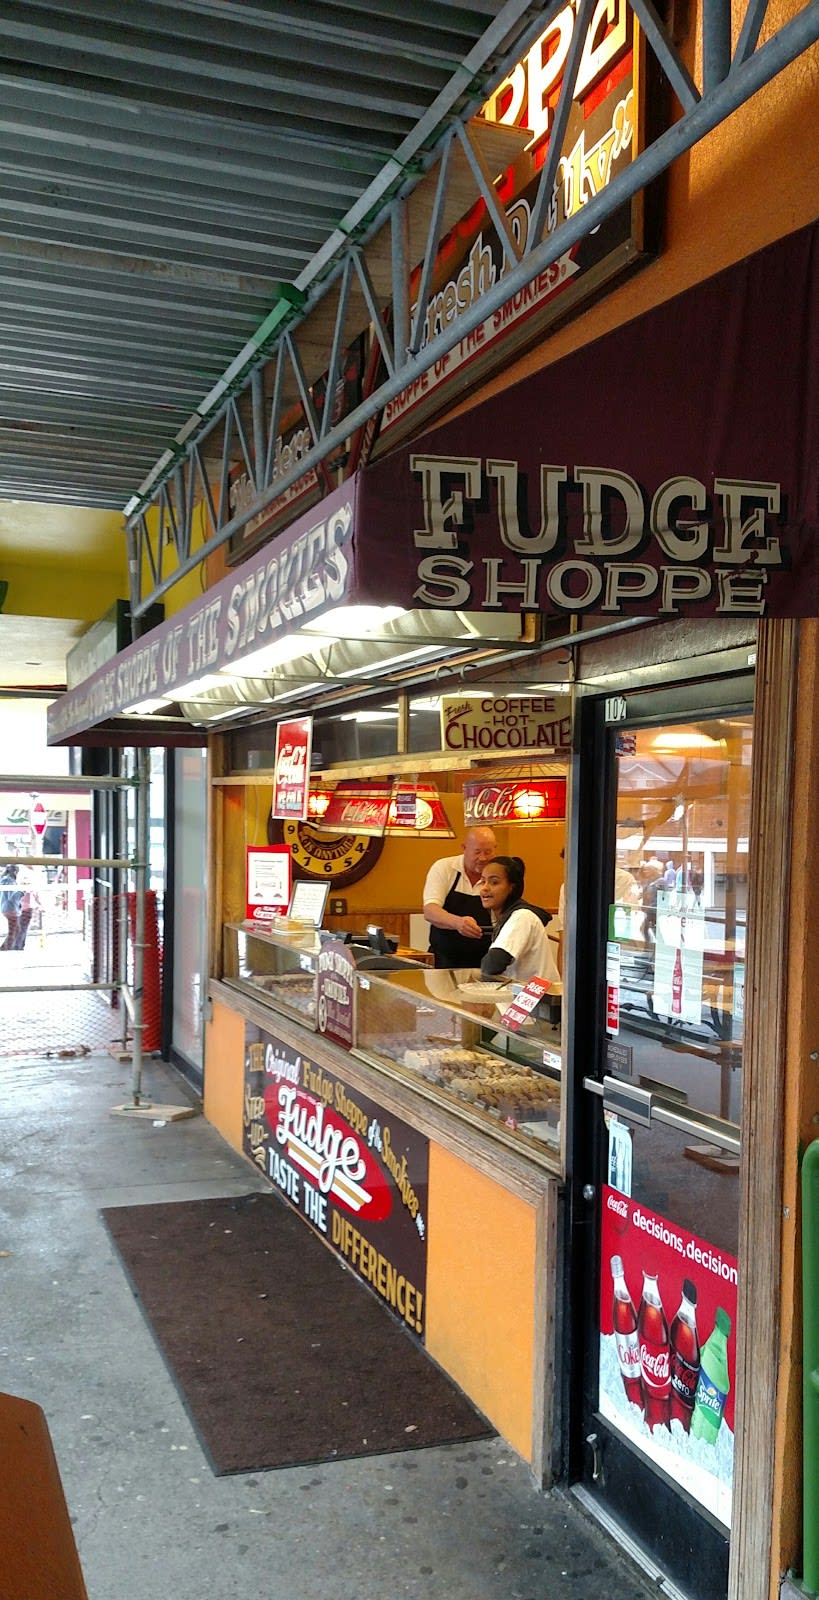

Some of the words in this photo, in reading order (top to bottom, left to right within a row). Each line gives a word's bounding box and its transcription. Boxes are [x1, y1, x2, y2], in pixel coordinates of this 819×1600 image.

[459, 325, 485, 357] THE
[493, 261, 560, 328] SMOKIES
[409, 453, 782, 564] FUDGE
[412, 554, 768, 615] SHOPPE
[117, 640, 160, 708] SHOPPE
[162, 625, 182, 686] OF
[186, 595, 222, 676] THE
[224, 502, 353, 658] SMOKIES
[445, 701, 472, 717] Fresh
[481, 698, 556, 713] COFFEE
[606, 697, 626, 720] 102
[445, 716, 571, 749] CHOCOLATE
[292, 843, 299, 854] 8
[355, 843, 365, 853] 4
[304, 857, 312, 866] 7
[324, 862, 332, 872] 6
[344, 857, 352, 867] 5
[249, 1043, 264, 1073] THE
[265, 1044, 301, 1085] Original
[303, 1061, 333, 1107] Fudge
[335, 1081, 368, 1136] Shoppe
[275, 1085, 366, 1194] Fudge
[268, 1146, 300, 1205] TASTE
[303, 1183, 328, 1233] THE
[332, 1210, 423, 1333] DIFFERENCE!
[619, 1343, 640, 1365] Coke
[672, 1374, 690, 1396] zero
[698, 1383, 720, 1410] Sprite
